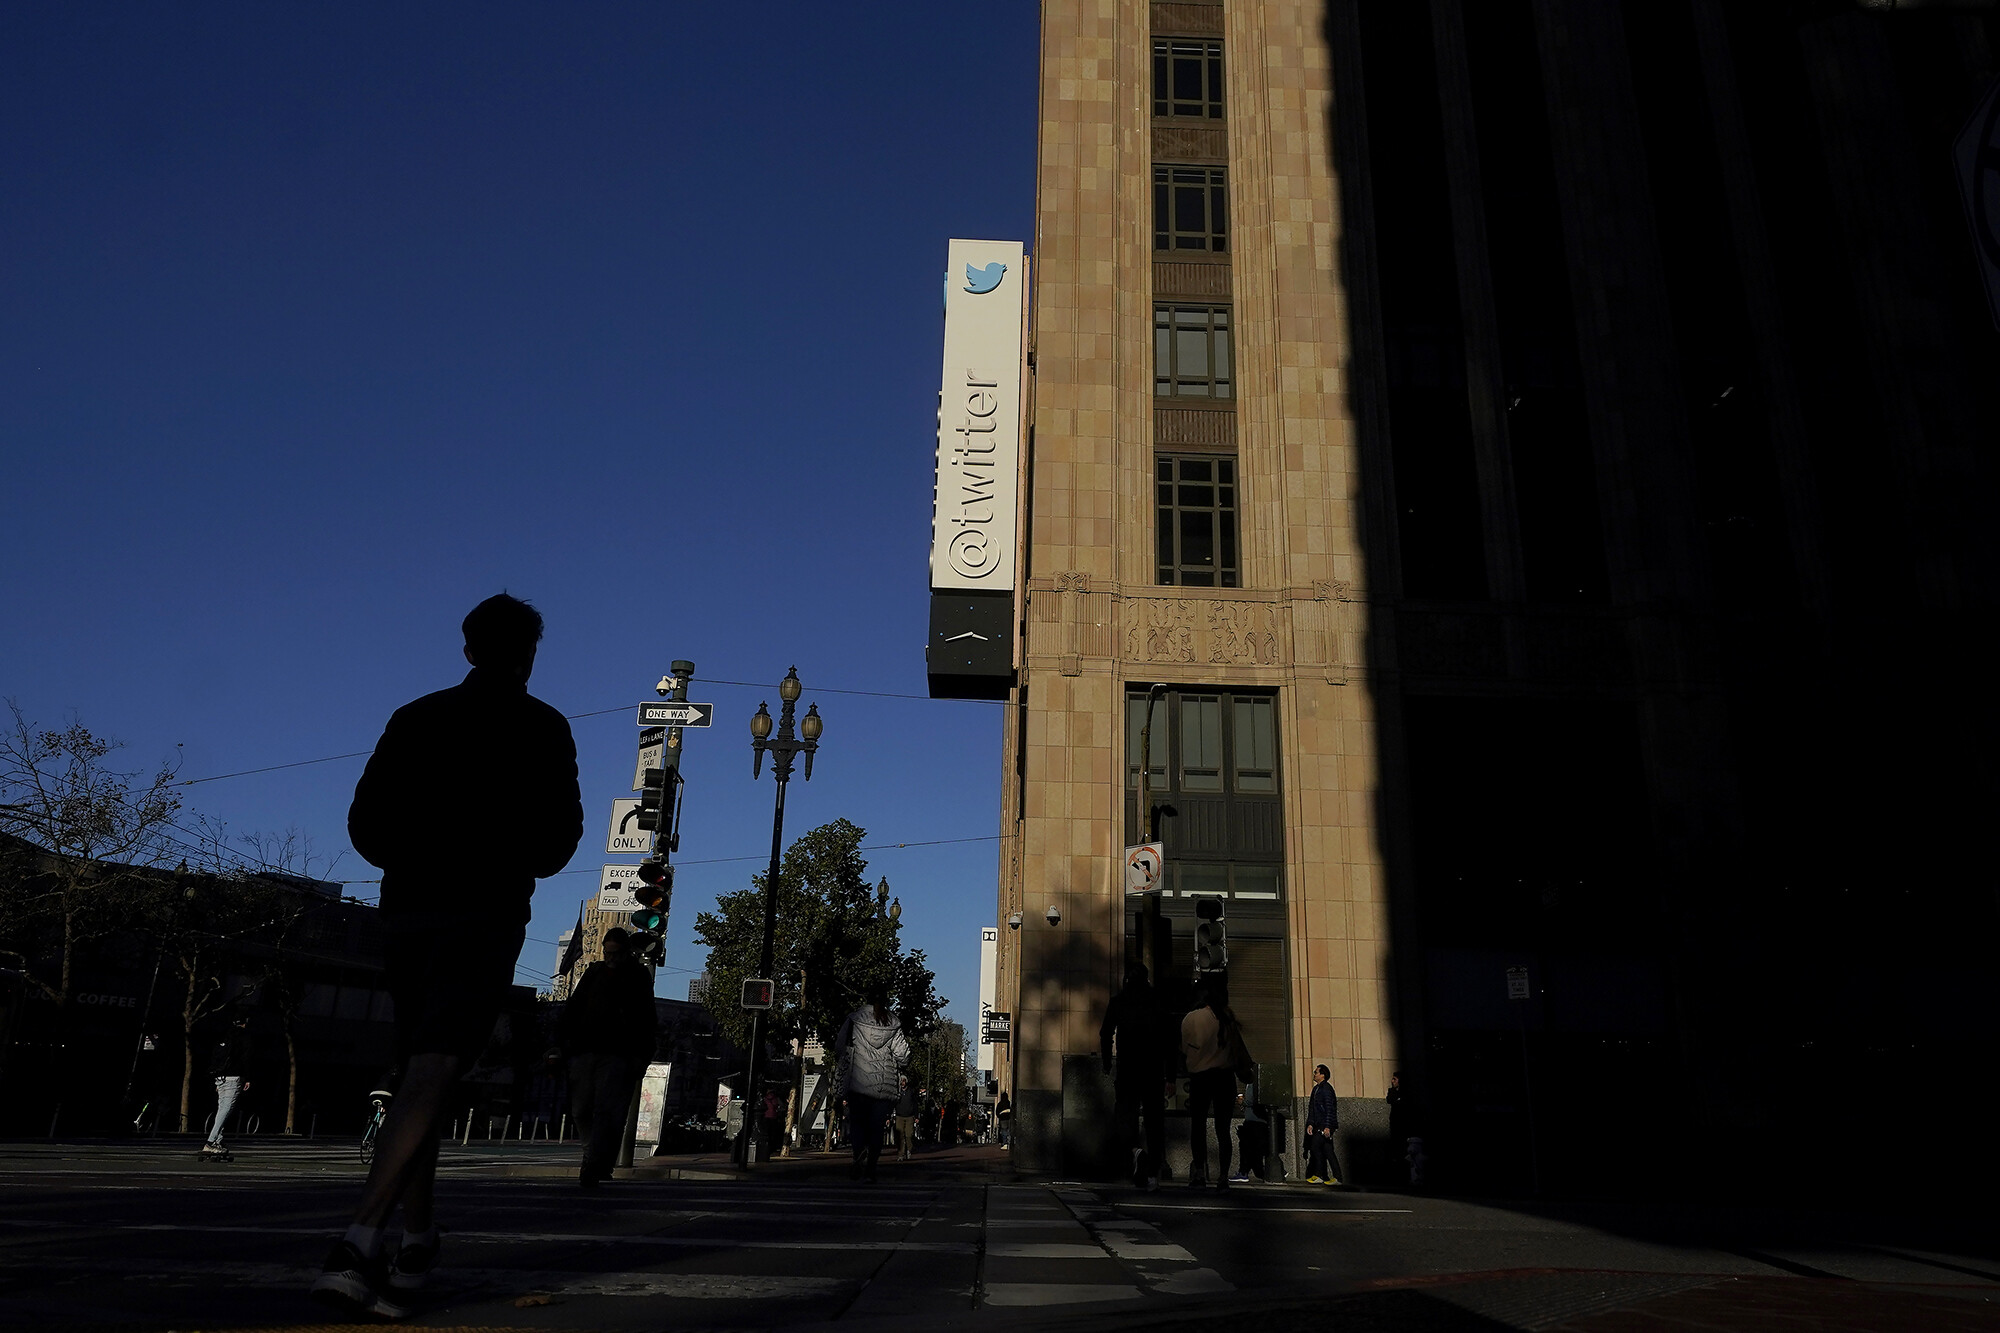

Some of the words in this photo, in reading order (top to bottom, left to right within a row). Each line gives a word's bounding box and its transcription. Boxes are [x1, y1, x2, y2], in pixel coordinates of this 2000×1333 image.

[947, 367, 1002, 579] @twitter
[648, 710, 666, 718] ONE
[670, 710, 690, 718] WAY
[613, 837, 645, 848] ONLY
[76, 992, 137, 1008] COFFEE
